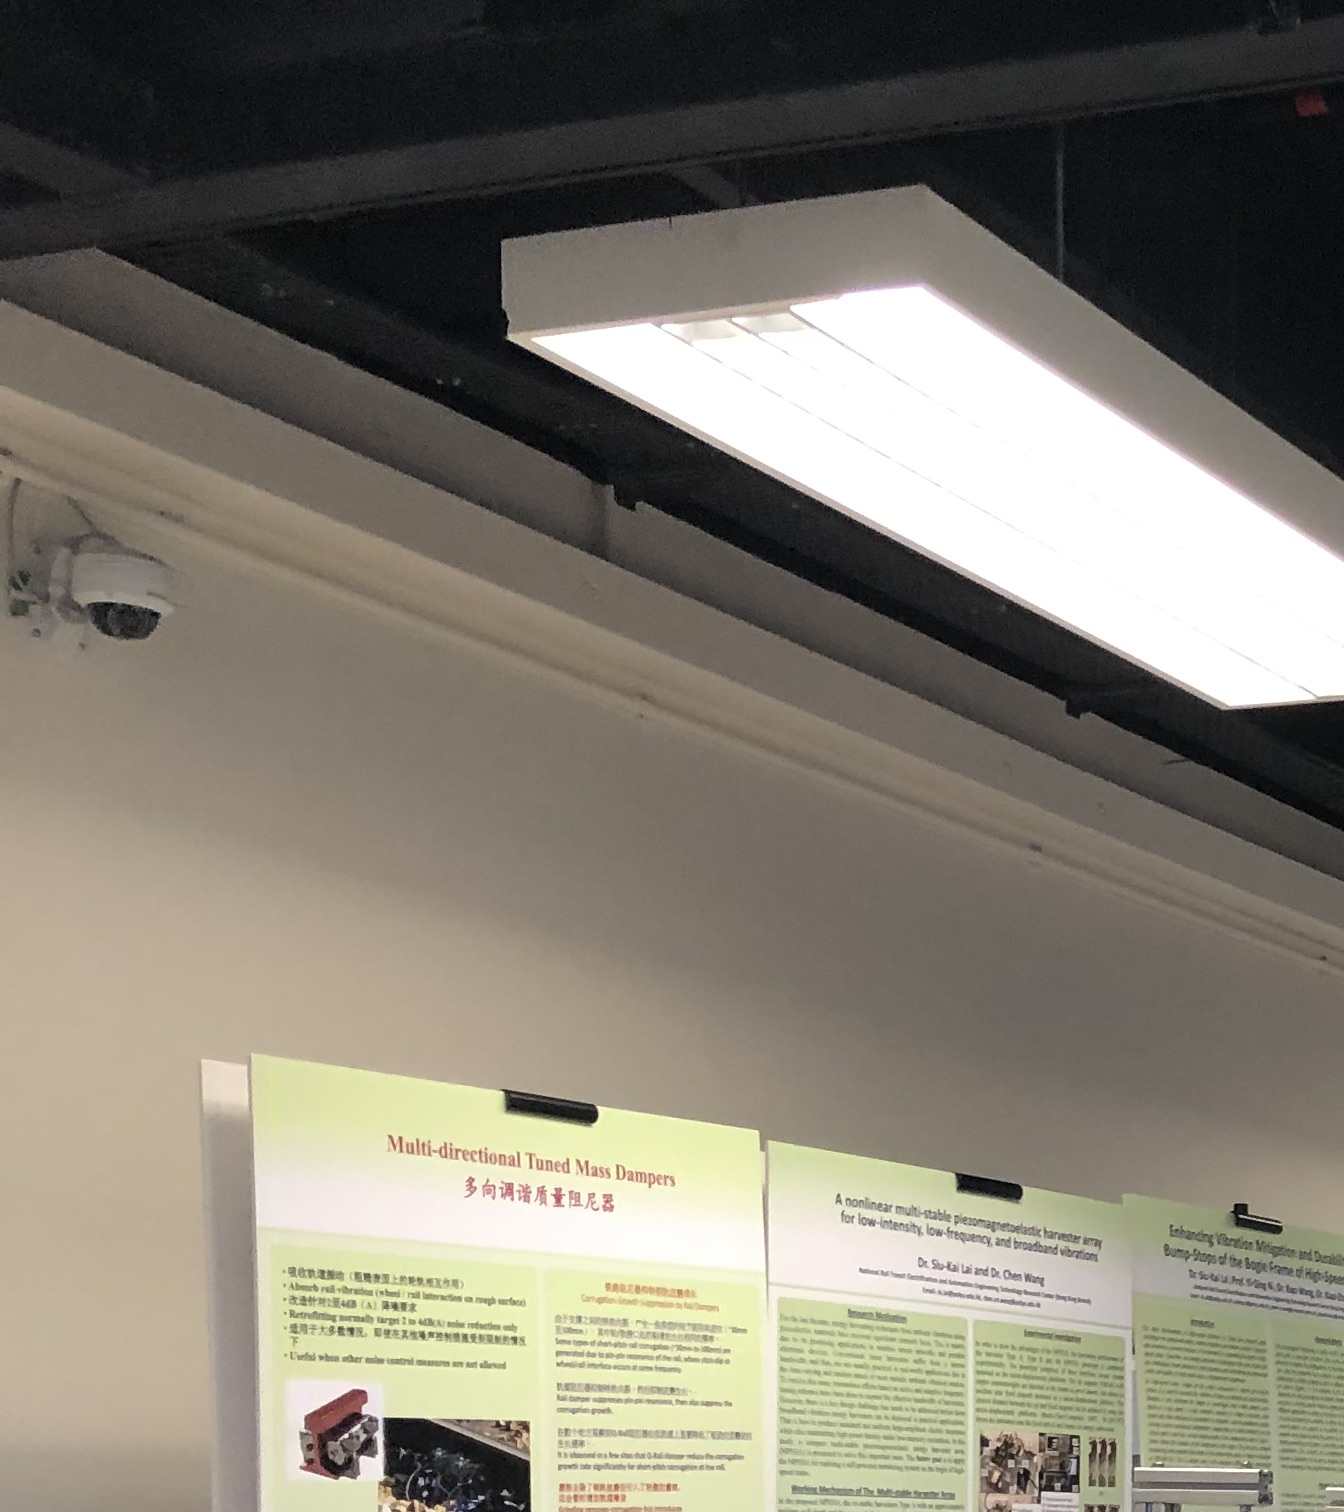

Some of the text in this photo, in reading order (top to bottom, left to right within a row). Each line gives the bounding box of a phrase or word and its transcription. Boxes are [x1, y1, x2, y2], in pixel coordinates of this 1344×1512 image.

[387, 1135, 676, 1190] Multi-directional Tuned Mass Dampers
[464, 1176, 615, 1214] 多向调谐质量阻尼器
[835, 1192, 1101, 1250] A nonlinear multi-stable piezomagnetoelastic harvester array
[841, 1212, 1097, 1261] for low-intensity, low-frequency, and broadband vibrations
[917, 1258, 1044, 1287] Dr. Siu-Kai Lai and Dr. Chen Wang
